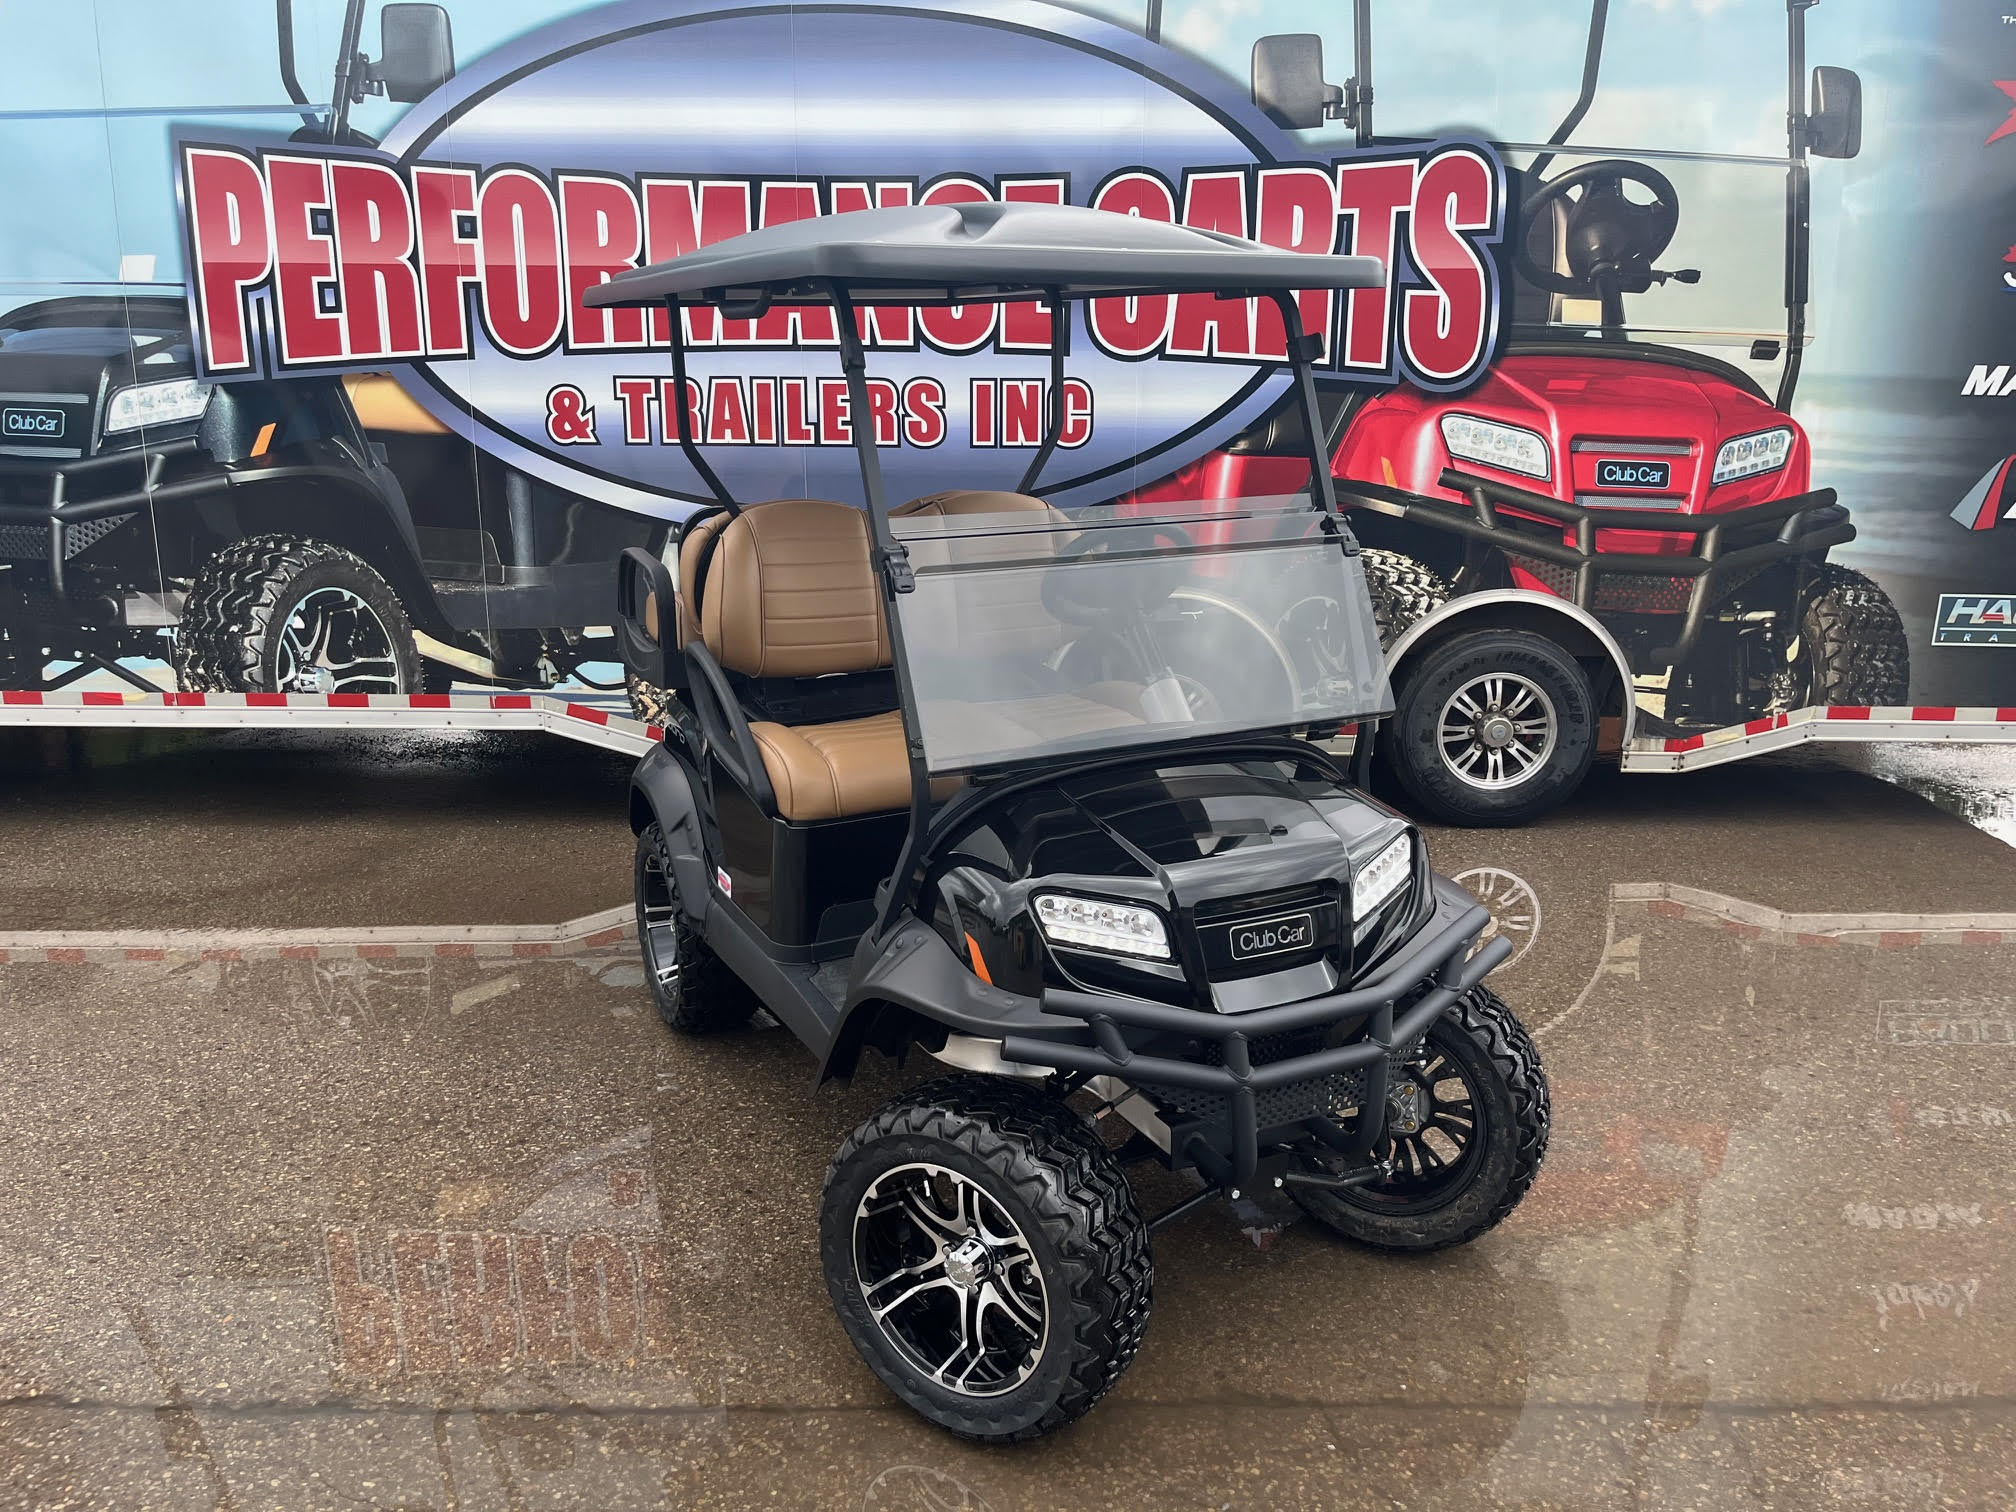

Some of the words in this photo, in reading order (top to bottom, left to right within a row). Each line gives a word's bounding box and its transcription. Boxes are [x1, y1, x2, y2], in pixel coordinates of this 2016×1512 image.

[1089, 150, 1493, 379] CARTS
[8, 414, 35, 430] Club
[36, 415, 58, 431] Car
[546, 385, 599, 444] &
[615, 377, 946, 447] TRAILERS
[972, 379, 1092, 447] INC
[1603, 465, 1636, 482] Club
[1637, 467, 1663, 483] Car
[1946, 598, 2016, 625] HA
[1239, 930, 1276, 951] Club
[1278, 925, 1305, 944] Car
